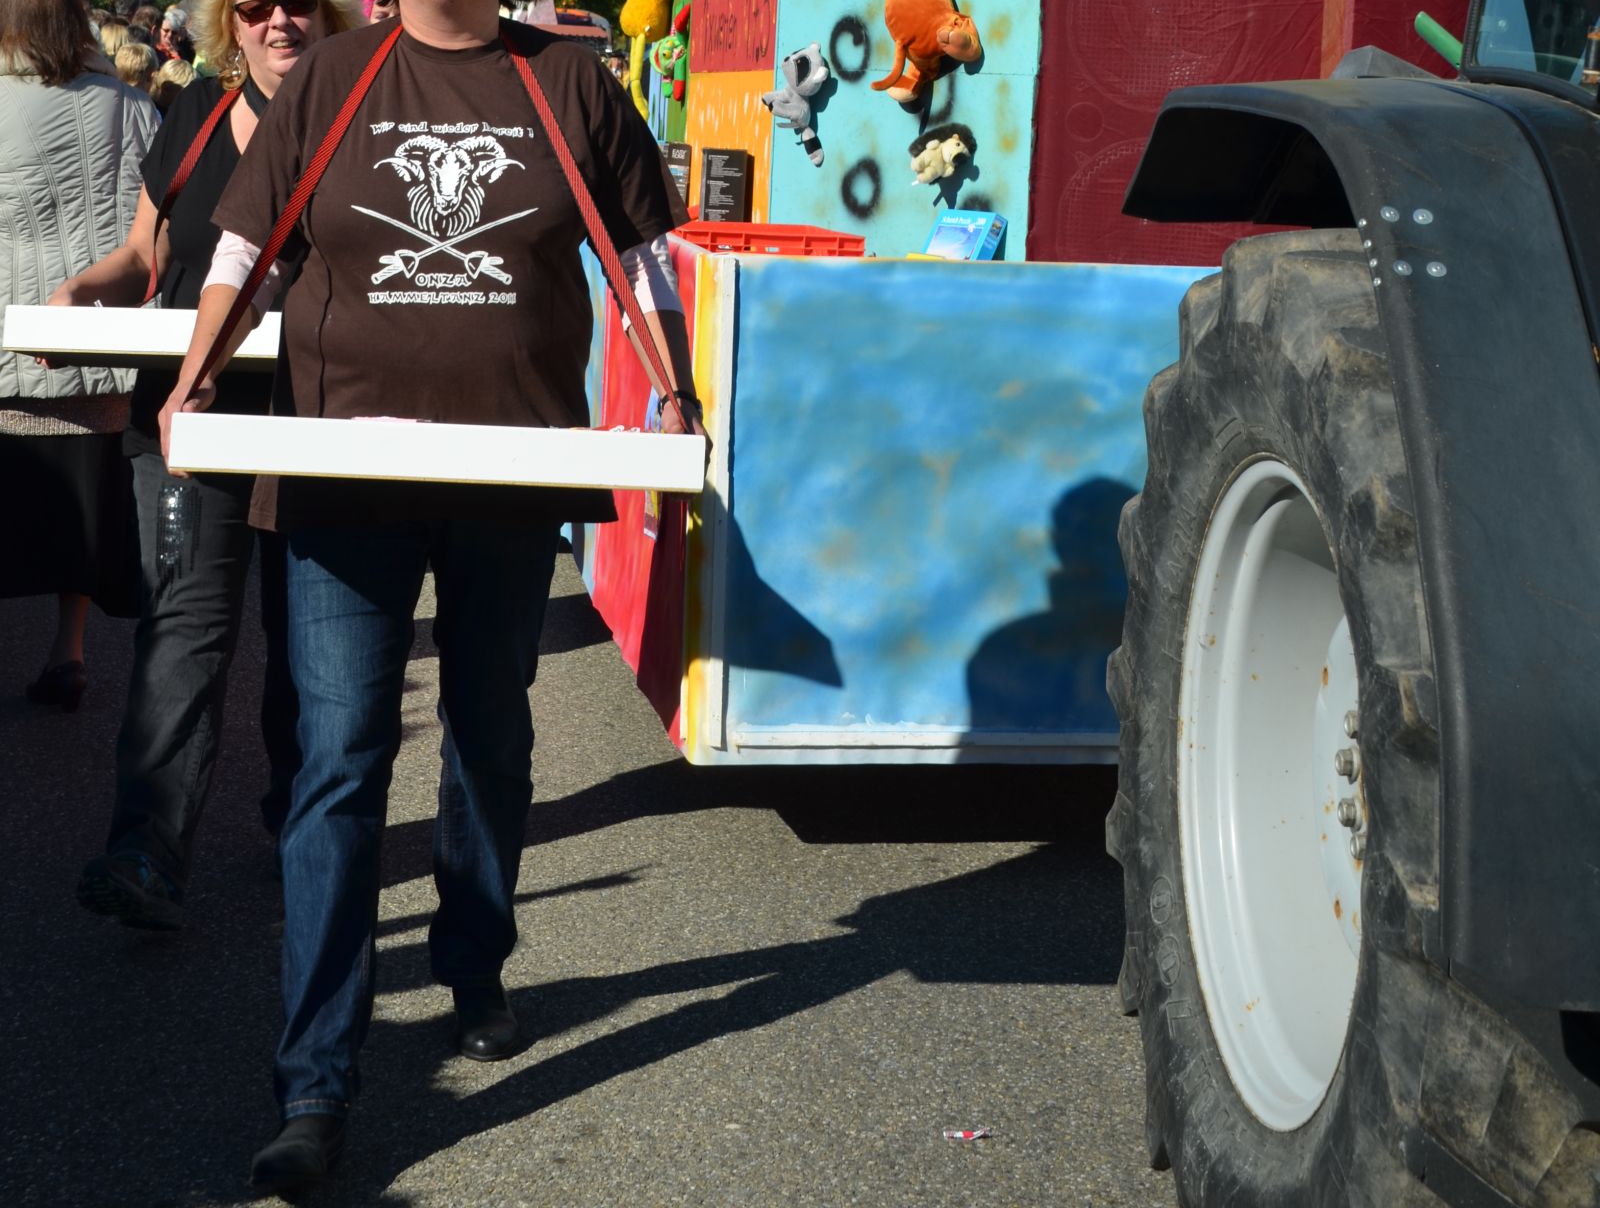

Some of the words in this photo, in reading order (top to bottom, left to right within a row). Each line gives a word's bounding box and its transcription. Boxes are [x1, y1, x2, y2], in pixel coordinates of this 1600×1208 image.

[369, 120, 395, 135] Wir
[398, 121, 429, 133] sind
[431, 121, 479, 135] wieder
[481, 121, 524, 138] bereit
[414, 272, 472, 289] ONZA
[367, 291, 486, 306] HAMMELTANZ
